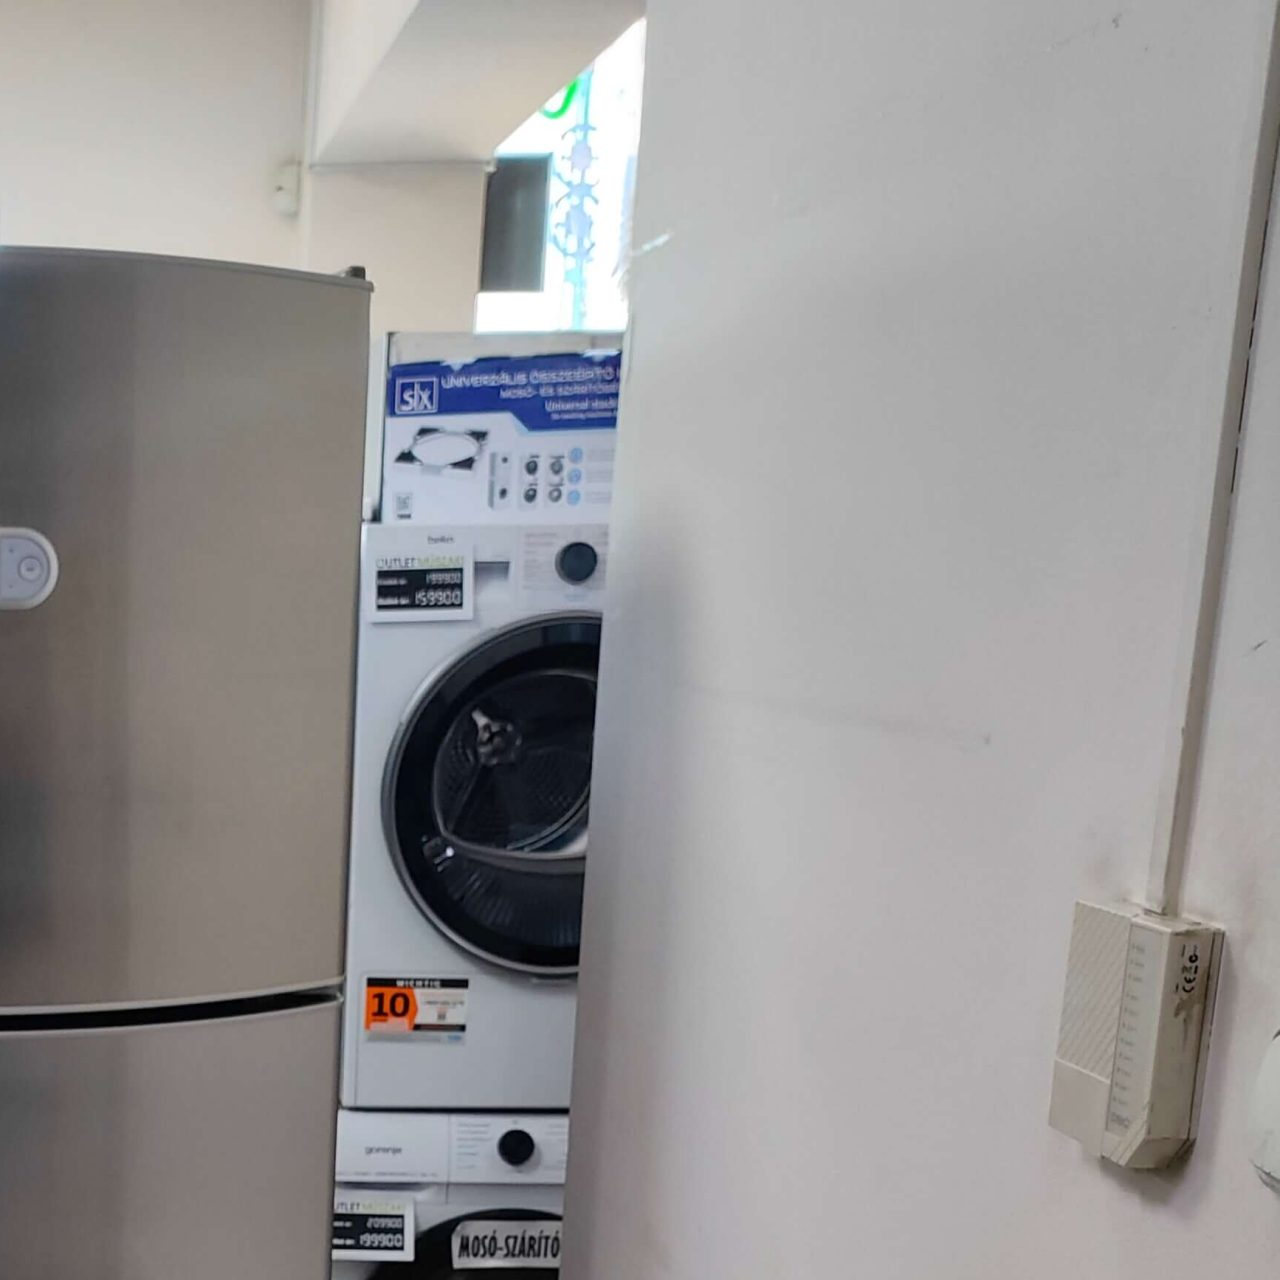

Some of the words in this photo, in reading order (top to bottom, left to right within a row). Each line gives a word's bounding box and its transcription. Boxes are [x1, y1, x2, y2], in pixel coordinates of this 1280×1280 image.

[371, 991, 411, 1018] 10
[364, 1145, 403, 1156] gorenje
[458, 1229, 561, 1259] MOSÓ-SZÁRÍTÓ
